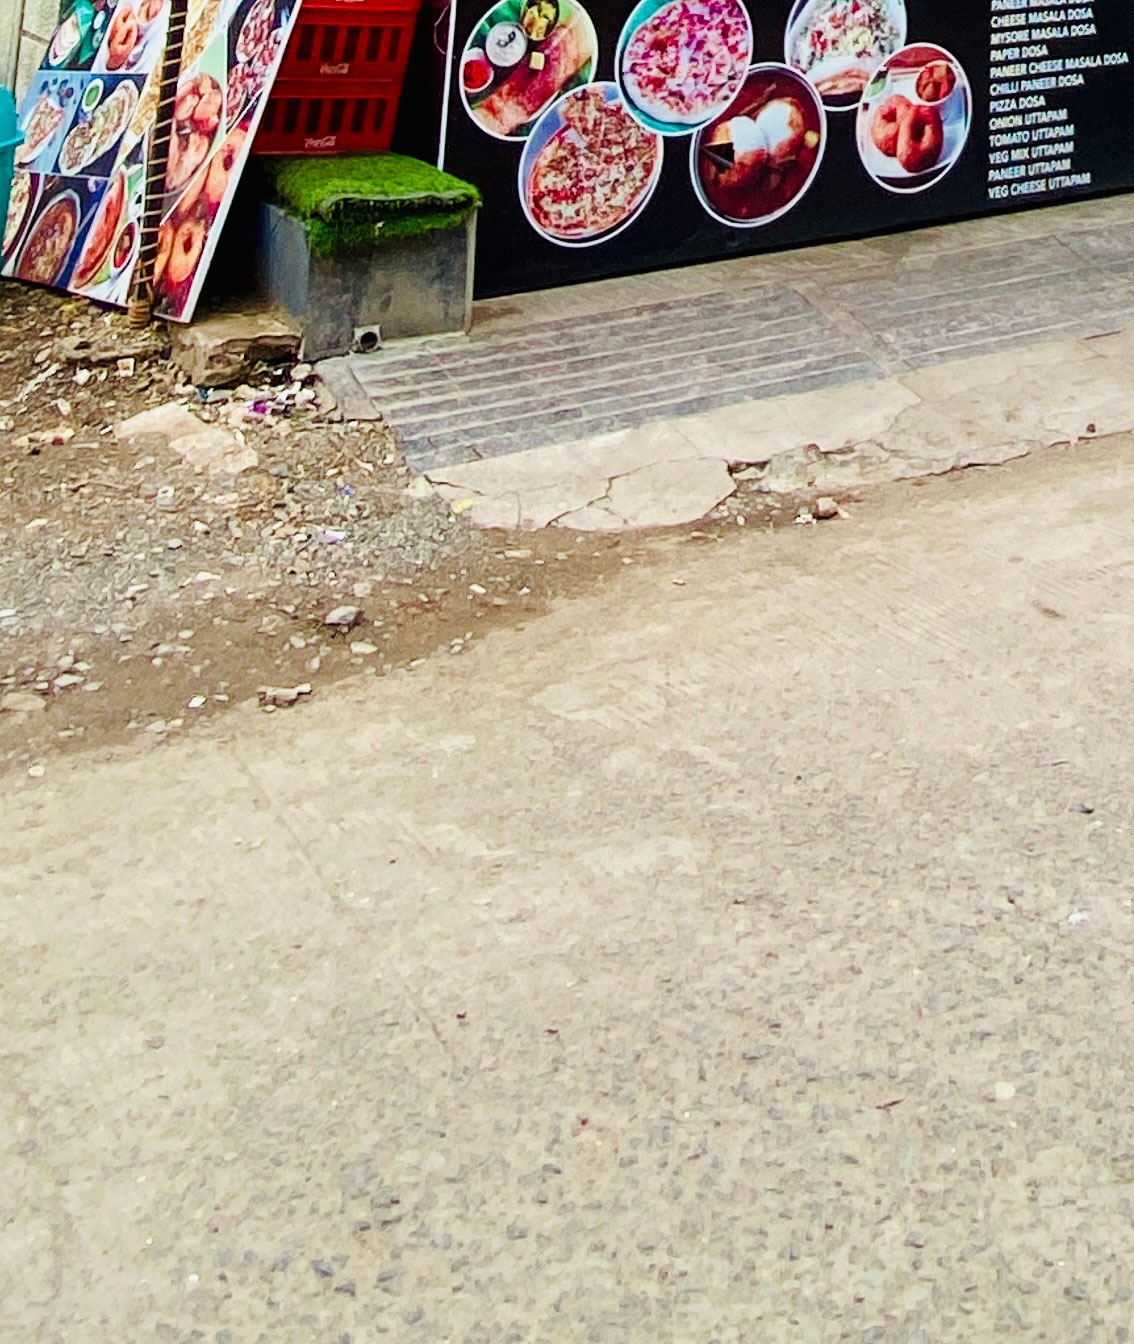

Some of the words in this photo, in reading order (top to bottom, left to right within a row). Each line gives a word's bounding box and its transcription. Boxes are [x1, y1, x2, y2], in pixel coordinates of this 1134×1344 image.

[991, 13, 1026, 28] CHEESE
[1028, 10, 1066, 24] MASALA
[1067, 7, 1094, 20] DOSA
[1031, 26, 1069, 41] MASALA
[1070, 23, 1097, 37] DOSA
[990, 47, 1019, 62] PAPER
[1021, 44, 1049, 58] DOSA
[990, 64, 1026, 79] PANEER
[1029, 59, 1063, 74] CHEESE
[1065, 55, 1101, 69] MASALA
[1103, 52, 1129, 65] DOSA
[1021, 77, 1056, 91] PANEER
[1058, 73, 1085, 87] DOSA
[990, 98, 1017, 113] PIZZA
[1019, 95, 1046, 110] DOSA
[1024, 108, 1068, 125] UTTAPAM
[989, 130, 1030, 147] TOMATO
[1032, 124, 1074, 141] UTTAPAM
[989, 151, 1009, 164] VEG
[1011, 148, 1029, 161] MIX
[1031, 141, 1074, 159] UTTAPAM
[988, 165, 1026, 181] PANEER
[1028, 158, 1071, 176] UTTAPAM
[988, 185, 1009, 199] VEG
[1010, 179, 1046, 196] CHEESE
[1048, 172, 1091, 190] UTTAPAM
